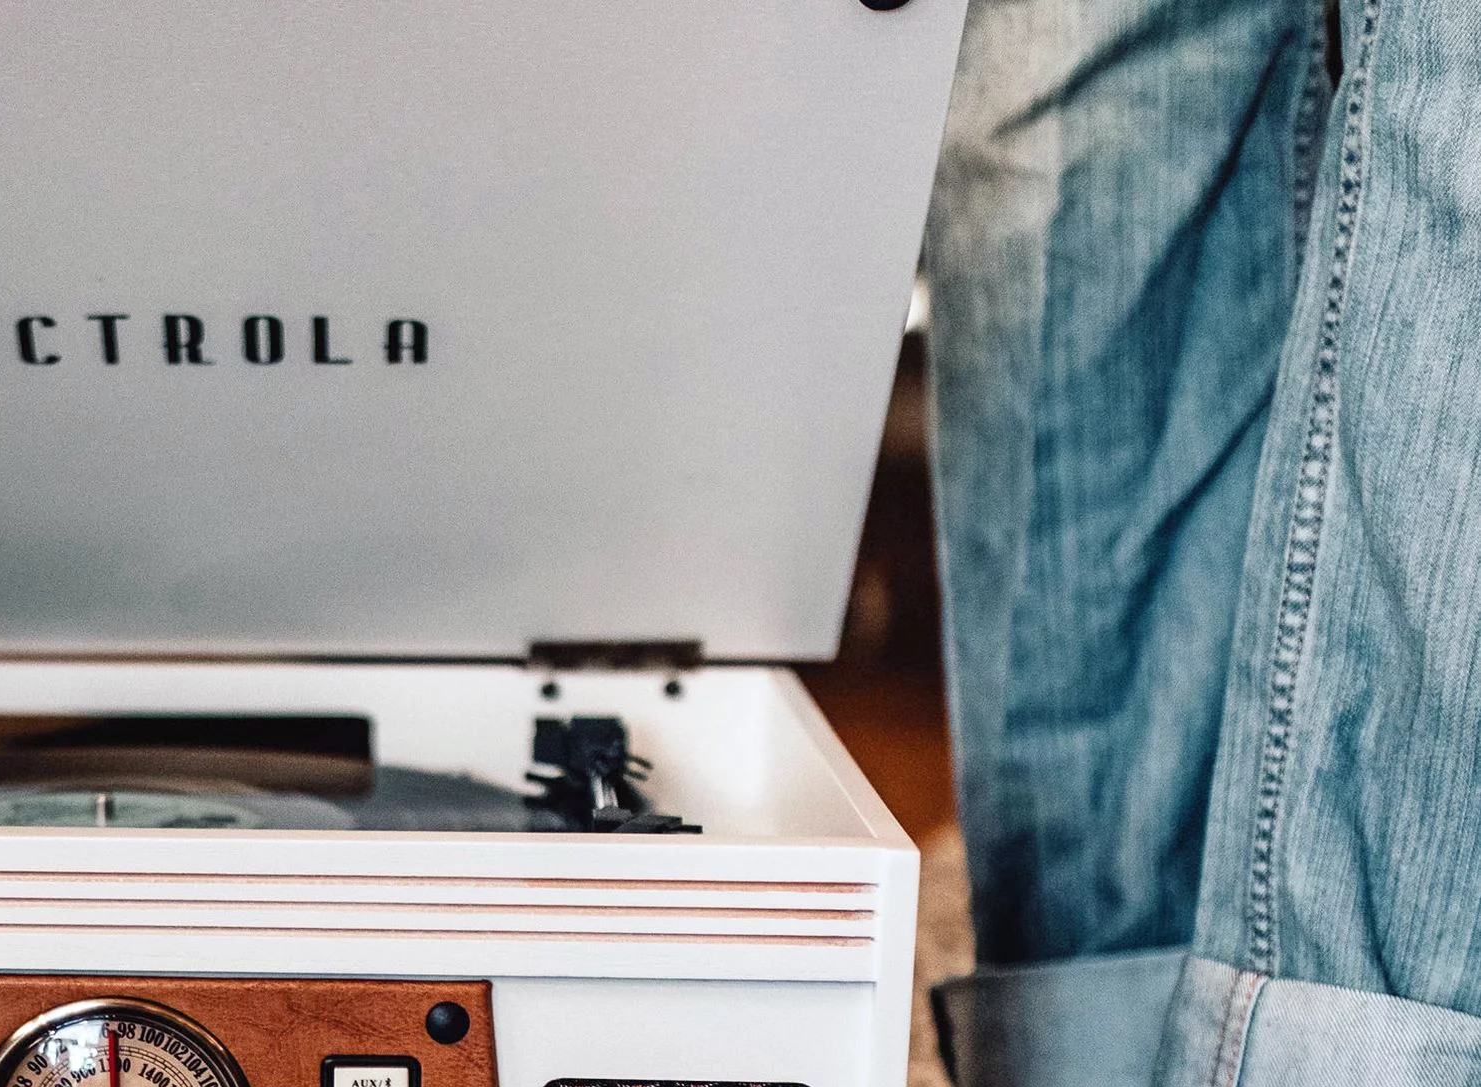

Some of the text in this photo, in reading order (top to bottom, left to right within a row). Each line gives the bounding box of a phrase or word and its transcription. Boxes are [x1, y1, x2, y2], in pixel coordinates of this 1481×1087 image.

[27, 1054, 48, 1075] 90
[117, 1022, 136, 1039] 98
[138, 1026, 165, 1047] 100
[161, 1037, 189, 1060] 102
[180, 1053, 206, 1079] 104
[99, 1057, 131, 1073] 100
